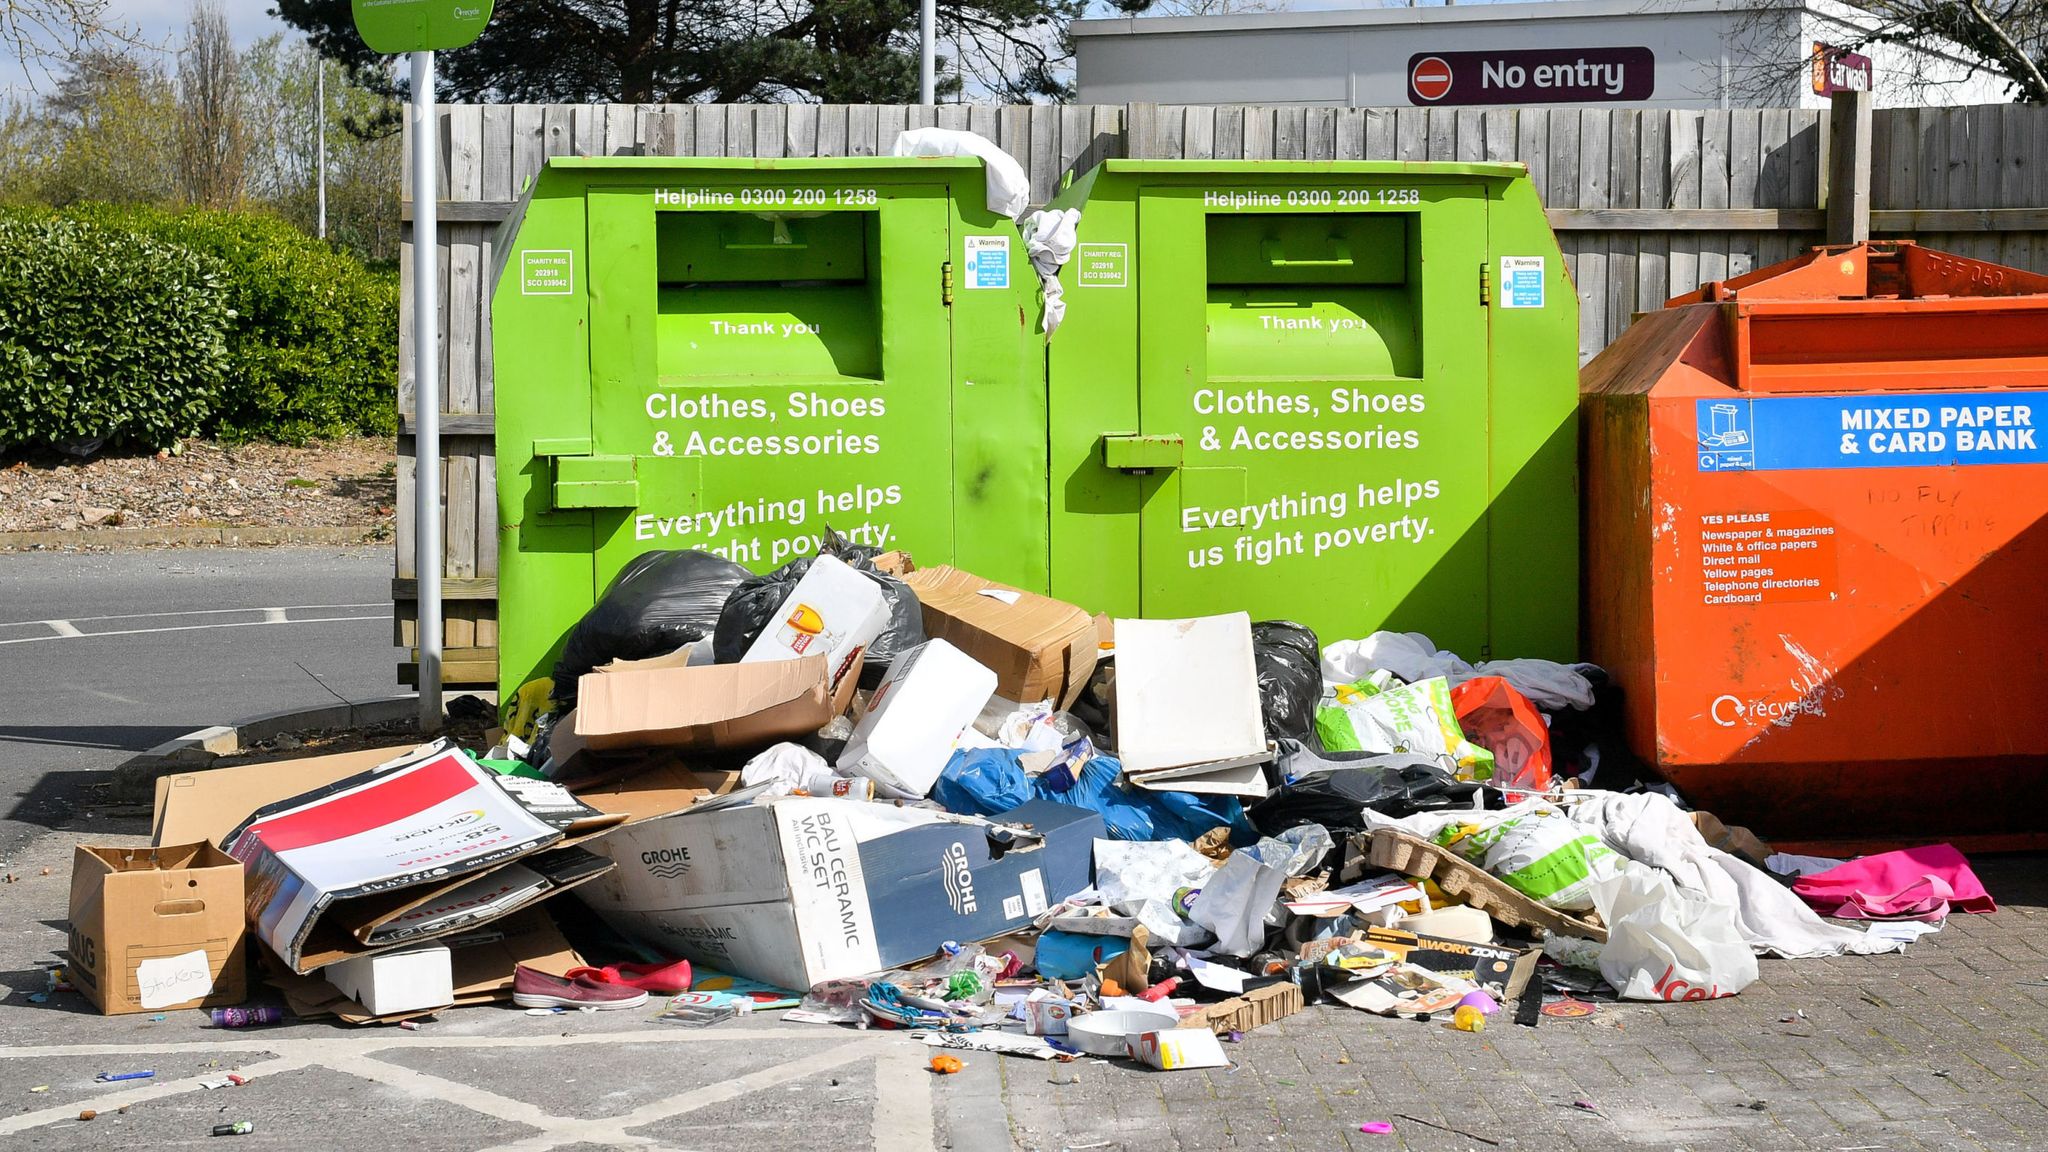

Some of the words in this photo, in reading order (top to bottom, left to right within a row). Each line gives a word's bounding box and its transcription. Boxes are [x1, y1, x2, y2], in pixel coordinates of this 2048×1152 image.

[1482, 60, 1526, 88] No
[1533, 58, 1624, 95] entry
[1845, 62, 1868, 91] wash
[655, 188, 734, 207] Helpline
[741, 189, 786, 204] 0300
[793, 189, 826, 204] 200
[834, 189, 877, 204] 1258
[1203, 190, 1282, 209] Helpline
[1287, 190, 1331, 206] 0300
[1338, 190, 1369, 205] 200
[1377, 189, 1419, 205] 1258
[710, 320, 775, 335] Thank
[782, 322, 820, 339] you
[1258, 315, 1322, 330] Thank
[1329, 317, 1367, 334] you
[646, 394, 776, 422] Clothes,
[788, 392, 886, 417] Shoes
[1193, 390, 1319, 418] Clothes,
[1330, 388, 1425, 413] Shoes
[1841, 408, 1930, 430] MIXED
[1941, 406, 2031, 428] PAPER
[653, 434, 675, 457] &
[684, 429, 880, 456] Accessories
[1200, 427, 1221, 451] &
[1230, 425, 1419, 451] Accessories
[1840, 433, 1860, 454] &
[1869, 431, 1945, 453] CARD
[1956, 429, 2037, 451] BANK
[635, 497, 806, 540] Everything
[817, 484, 902, 514] helps
[1182, 488, 1346, 533] Everything
[1358, 476, 1440, 508] helps
[1701, 516, 1723, 524] YES
[1727, 513, 1770, 523] PLEASE
[1188, 547, 1223, 569] us
[1234, 530, 1303, 567] fight
[1313, 514, 1435, 559] poverty.
[1702, 529, 1762, 541] Newspaper
[1765, 528, 1773, 537] &
[1776, 526, 1834, 538] magazines
[1702, 542, 1733, 552] White
[1736, 542, 1744, 551] &
[1747, 541, 1777, 551] office
[1780, 540, 1817, 551] papers
[1703, 555, 1735, 565] Direct
[1738, 554, 1760, 564] mail
[1703, 568, 1737, 578] Yellow
[1741, 567, 1774, 578] pages
[1704, 580, 1758, 592] Telephone
[1762, 578, 1820, 589] directories
[1704, 592, 1762, 604] Cardboard
[398, 835, 512, 867] TOSHIBA
[466, 857, 484, 867] HD
[485, 845, 520, 862] ULTRA
[641, 847, 691, 866] GROHE
[796, 834, 809, 875] inclusive
[801, 815, 821, 848] WC
[811, 852, 830, 891] SET
[816, 811, 841, 852] BAU
[829, 857, 860, 948] CERAMIC
[951, 842, 978, 915] GROHE
